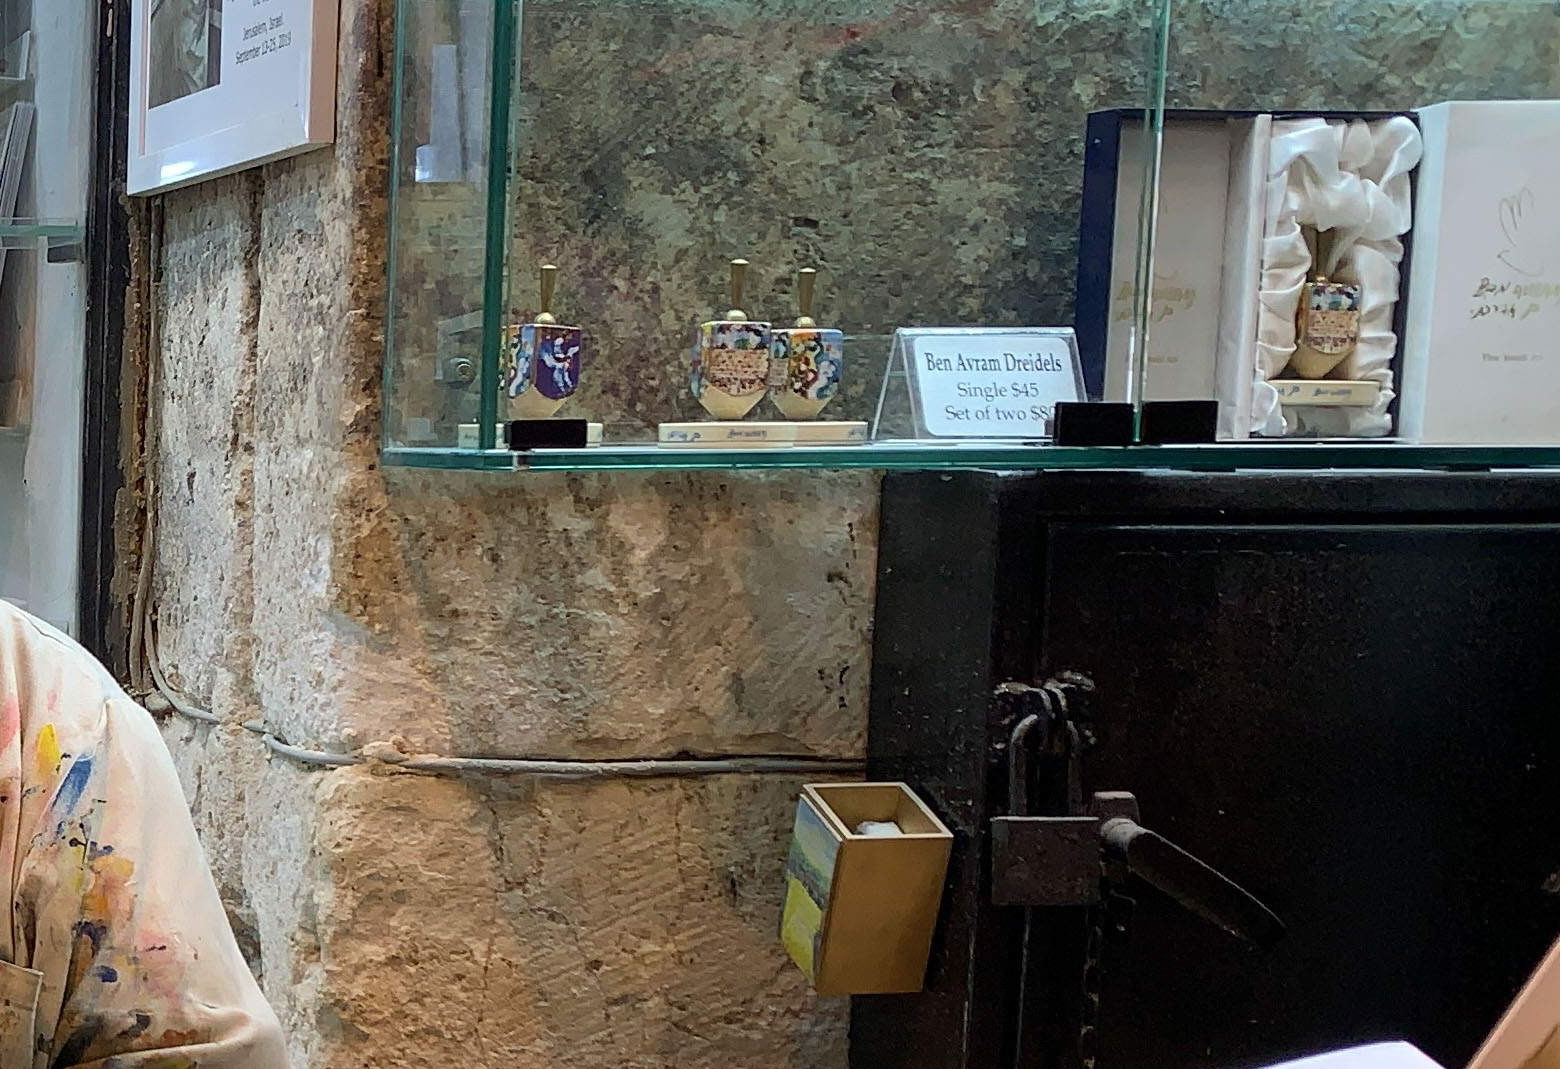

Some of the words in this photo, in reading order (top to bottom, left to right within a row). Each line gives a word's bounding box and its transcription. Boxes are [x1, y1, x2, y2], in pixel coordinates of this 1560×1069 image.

[924, 352, 952, 372] Ben
[956, 352, 1001, 372] Avram
[1003, 352, 1062, 372] Dreidels
[957, 382, 1008, 402] Single
[1011, 382, 1039, 398] $45
[945, 405, 969, 421] Set
[975, 405, 991, 421] of
[995, 407, 1027, 421] two
